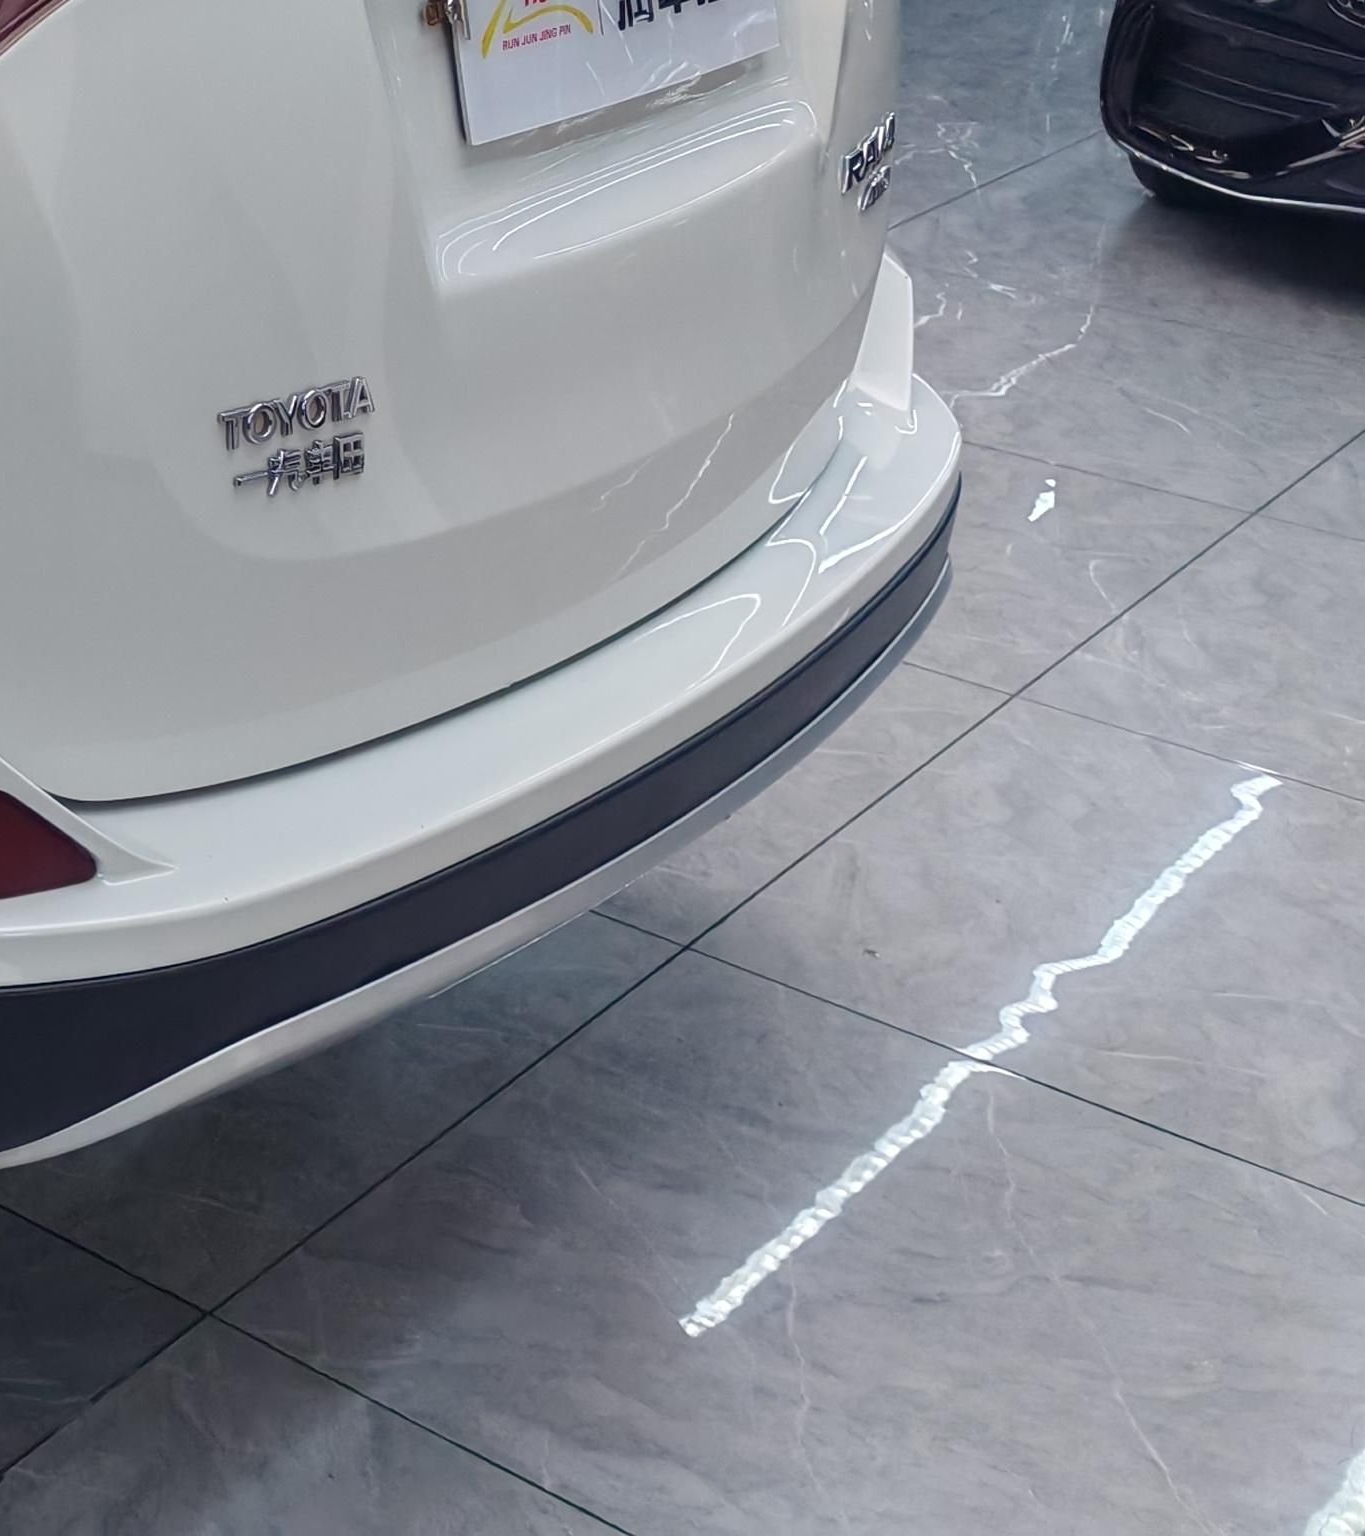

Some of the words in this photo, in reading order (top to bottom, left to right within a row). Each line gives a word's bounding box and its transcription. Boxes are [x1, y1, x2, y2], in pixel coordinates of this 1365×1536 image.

[502, 37, 520, 50] RUN
[521, 33, 538, 46] JUN
[539, 27, 558, 41] JING
[559, 24, 571, 37] PIN
[217, 376, 375, 450] TOYOTA
